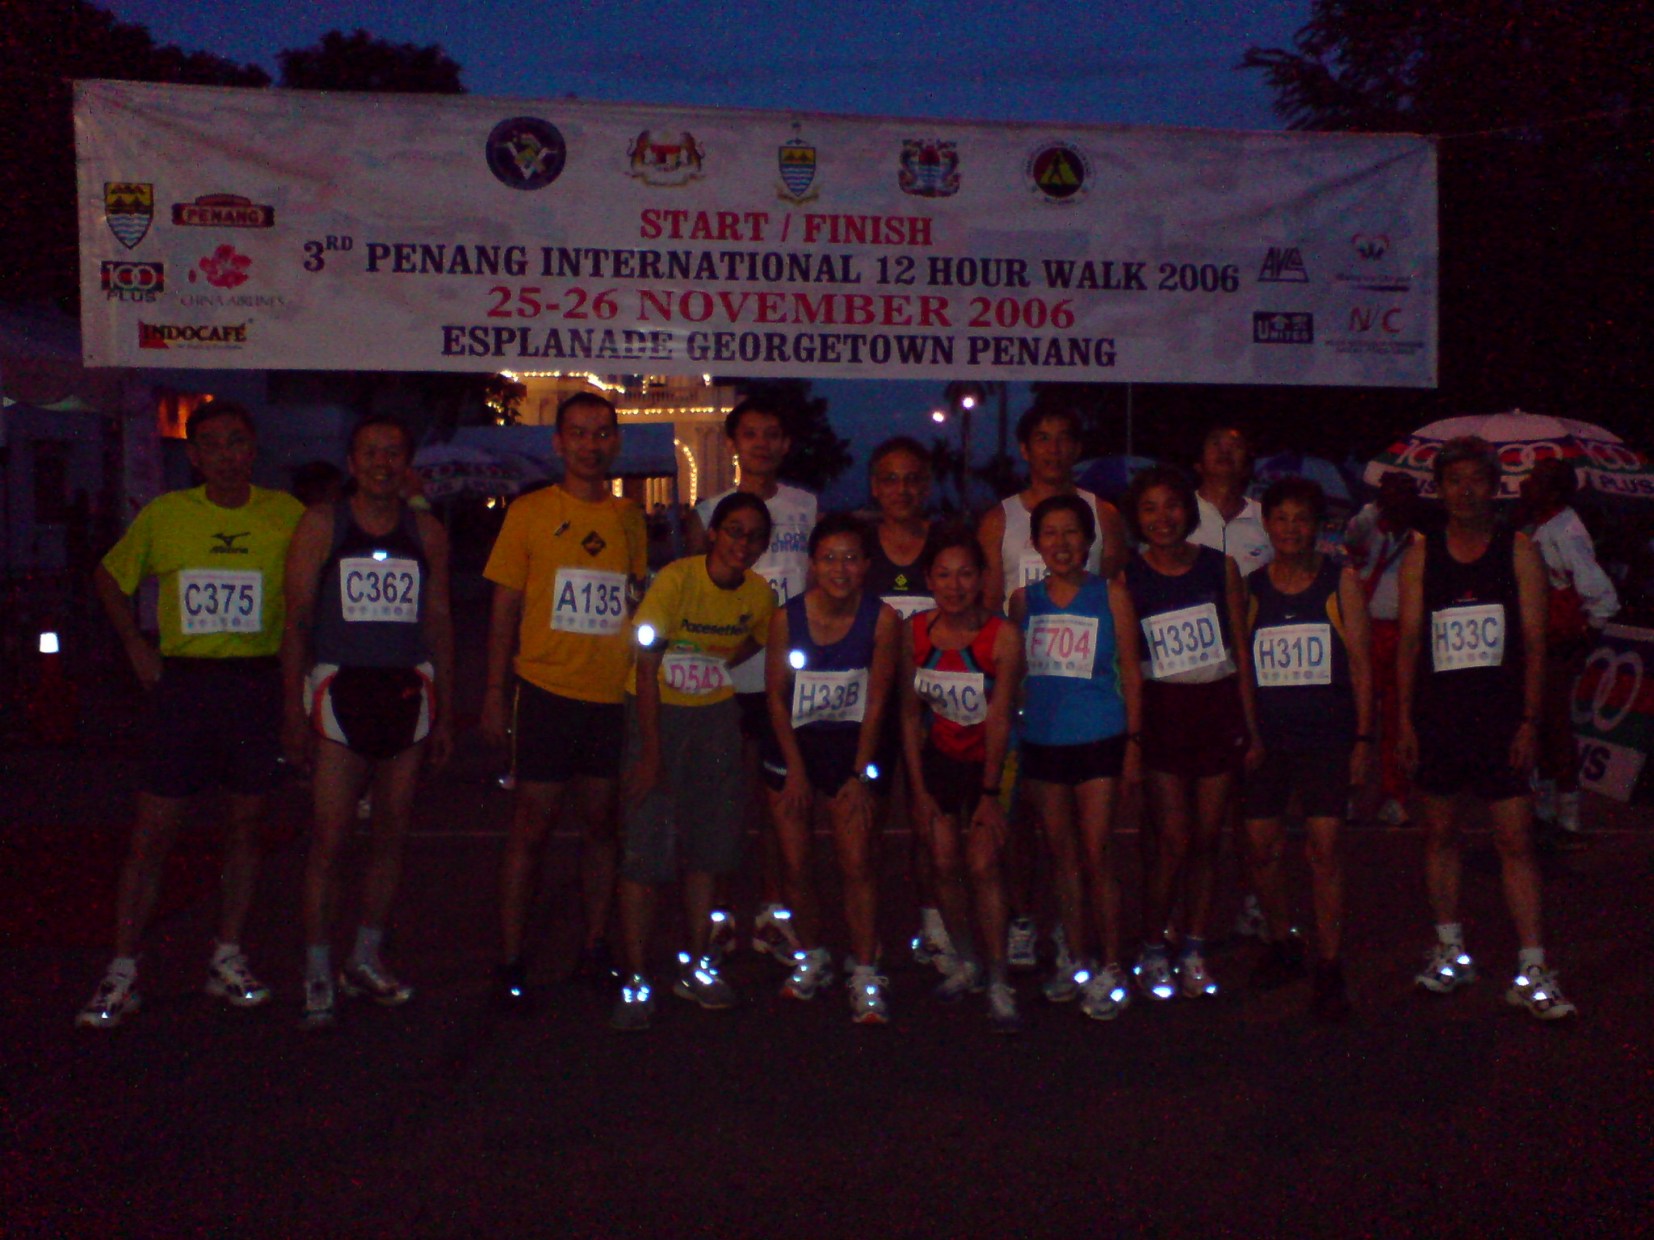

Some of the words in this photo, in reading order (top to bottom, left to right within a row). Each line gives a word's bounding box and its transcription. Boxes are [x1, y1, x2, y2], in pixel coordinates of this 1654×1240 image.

[187, 208, 260, 224] PENANG
[640, 208, 768, 242] START
[781, 212, 792, 243] /
[804, 213, 933, 246] FINISH
[303, 235, 354, 273] 3RD
[366, 242, 528, 276] PENANG
[541, 247, 861, 285] INTERNATIONAL
[876, 255, 916, 285] 12
[927, 256, 1030, 288] HOUR
[1042, 258, 1148, 291] WALK
[1158, 262, 1240, 293] 2006
[106, 290, 157, 303] PLUS
[487, 286, 618, 321] 25-26
[636, 288, 952, 328] NOVEMBER
[968, 296, 1076, 329] 2006
[442, 325, 673, 360] ESPLANADE
[686, 331, 954, 365] GEORGETOWN
[967, 335, 1117, 367] PENANG
[184, 582, 254, 617] C375
[346, 570, 414, 604] C362
[556, 580, 623, 616] A135
[1030, 626, 1091, 660] F704
[1151, 616, 1216, 661] H33D
[1435, 616, 1499, 651] H33C
[1258, 635, 1324, 670] H31D
[799, 680, 860, 713] H33B
